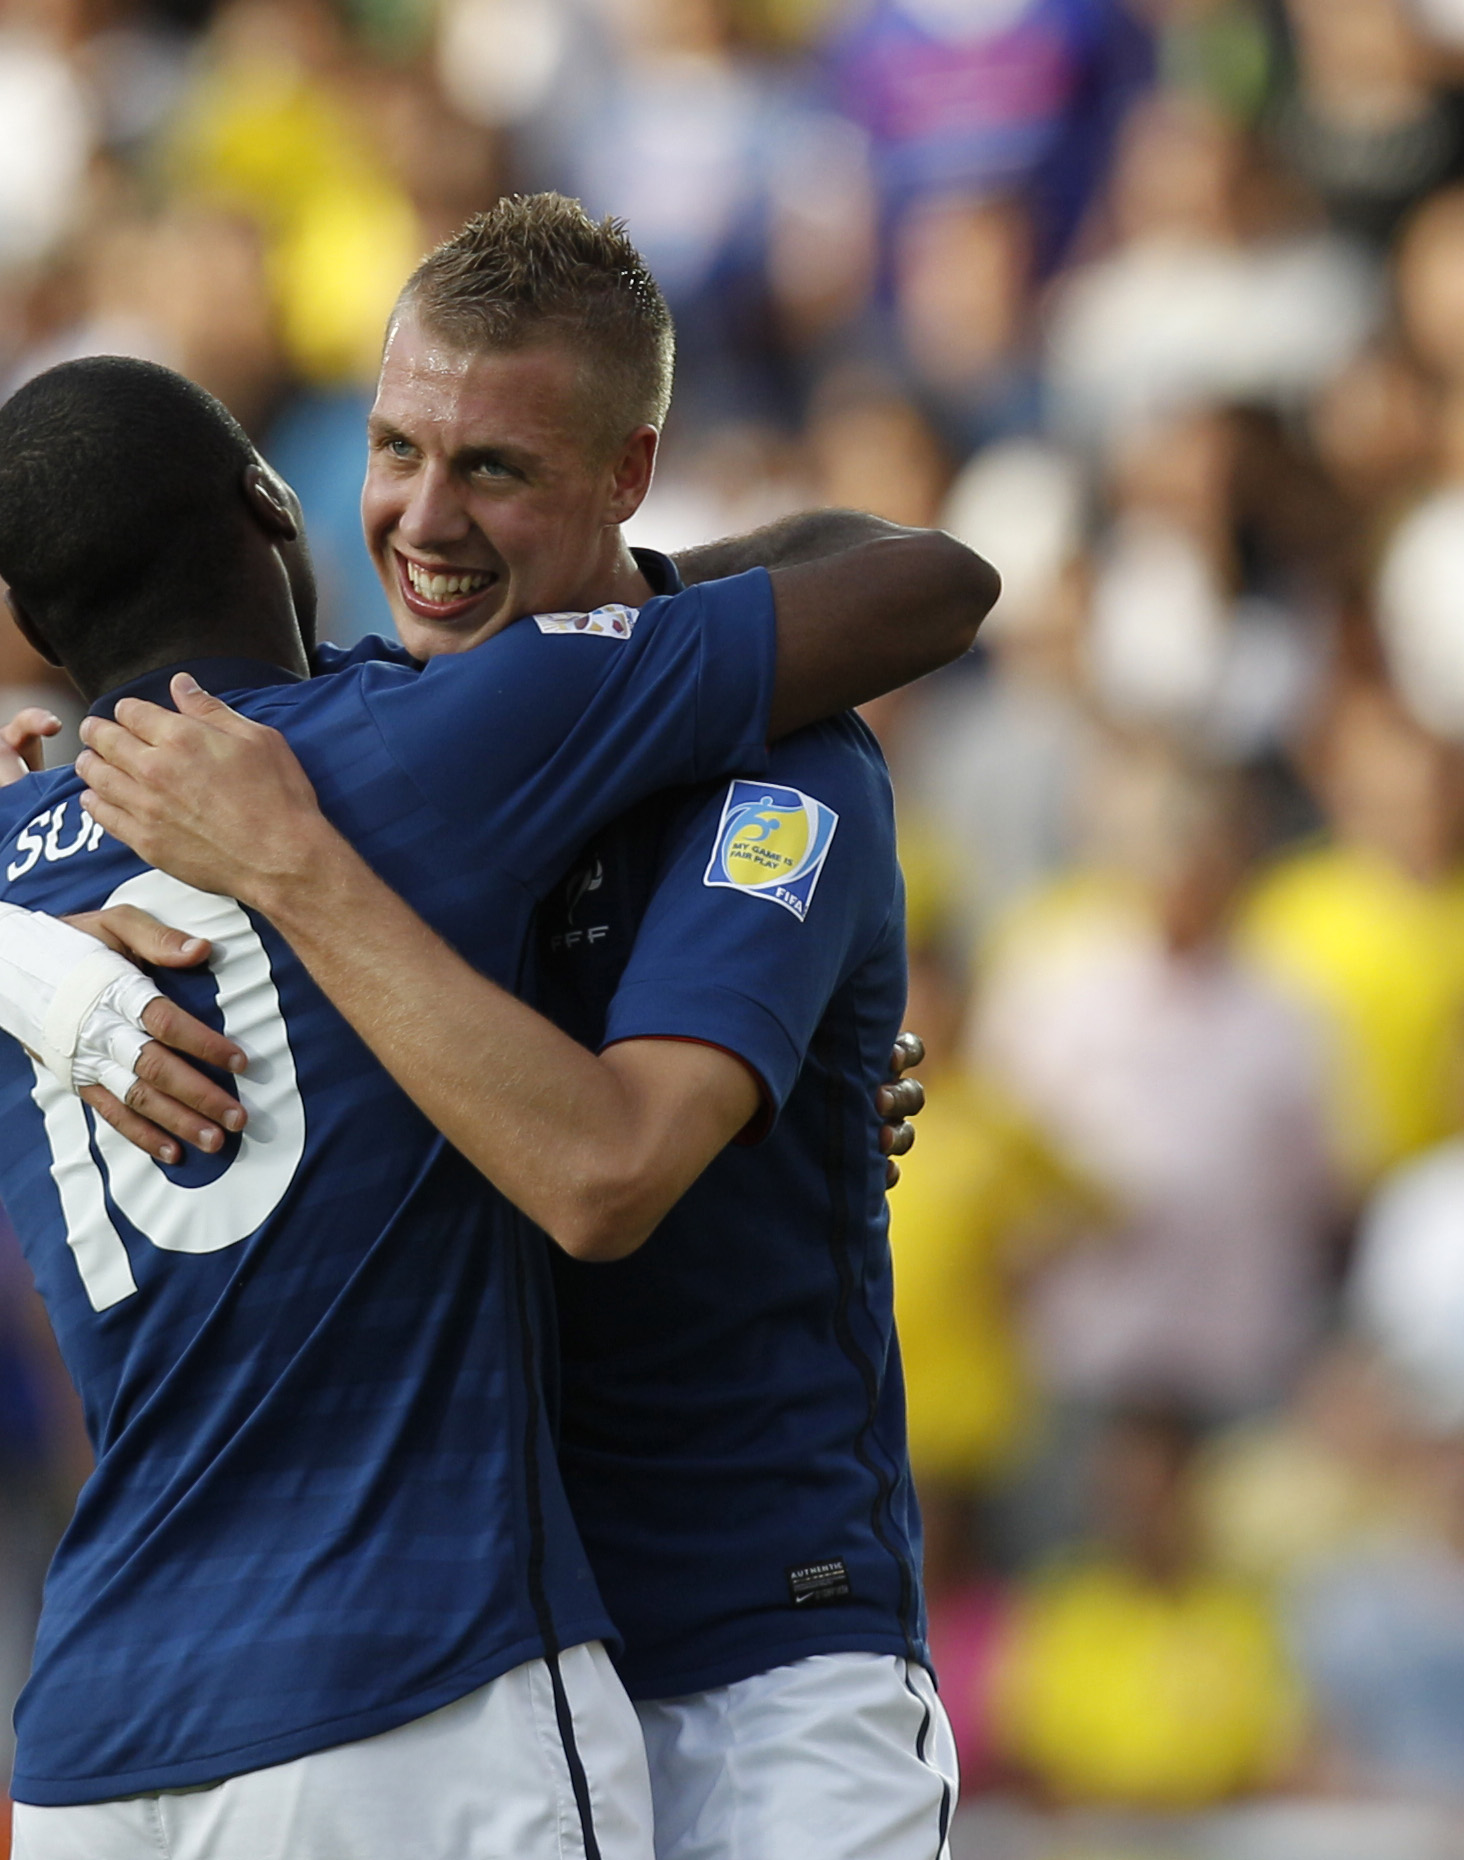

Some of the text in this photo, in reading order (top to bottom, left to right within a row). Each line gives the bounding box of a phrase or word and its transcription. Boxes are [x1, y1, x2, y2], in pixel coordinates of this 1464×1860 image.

[730, 851, 779, 869] FAIR PLAY
[732, 842, 793, 866] MY GAME IS
[776, 887, 803, 913] FIFA
[550, 925, 609, 952] FFF
[24, 868, 306, 1313] 10
[790, 1561, 843, 1579] AUTHENTIC
